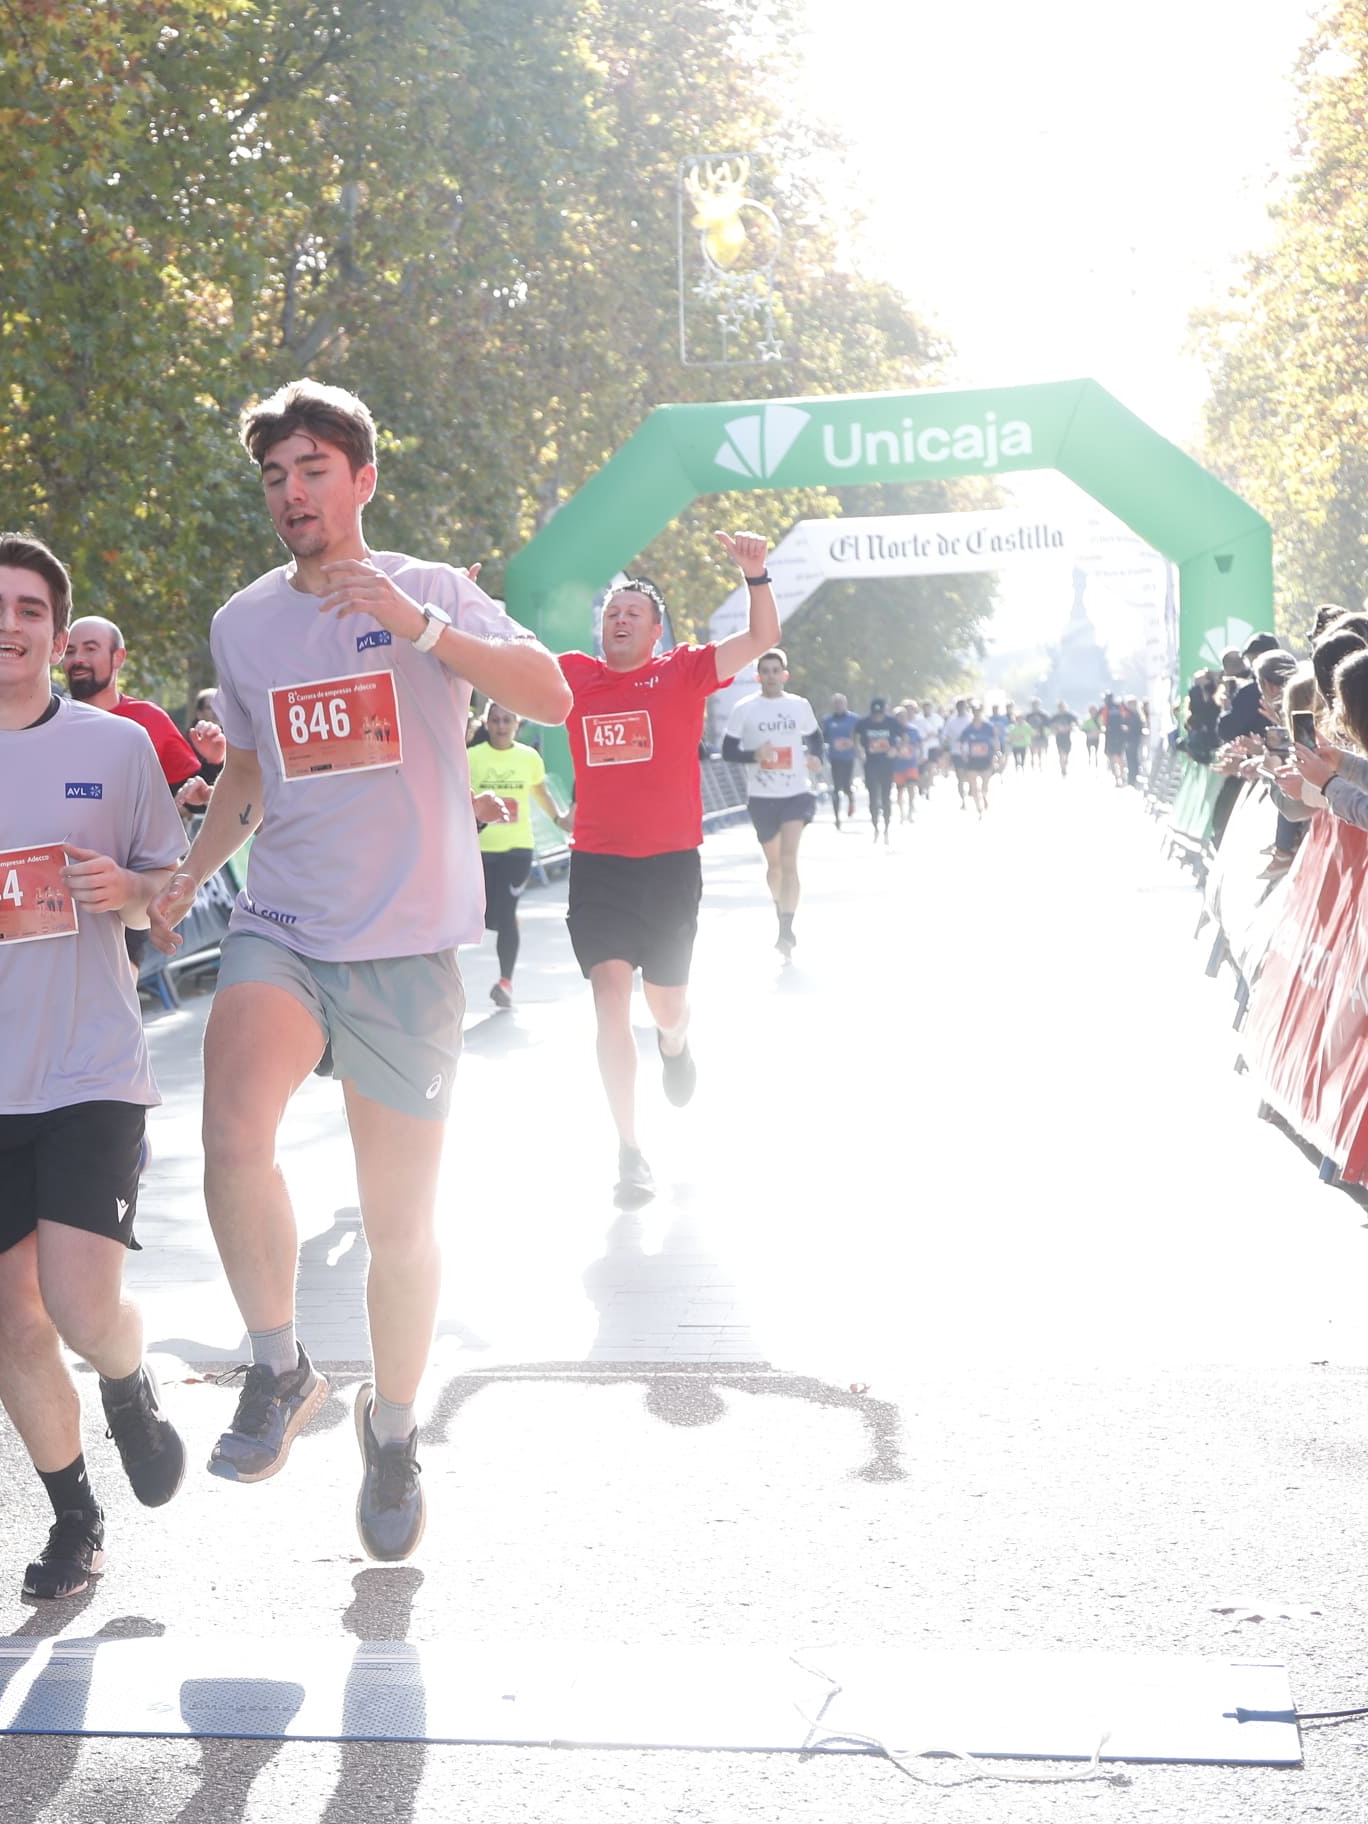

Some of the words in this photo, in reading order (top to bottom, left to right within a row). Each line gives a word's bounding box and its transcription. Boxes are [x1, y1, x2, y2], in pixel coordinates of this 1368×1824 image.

[822, 411, 1033, 468] Unicaja
[829, 534, 860, 562] El
[866, 533, 931, 561] Norte
[936, 532, 960, 556] de
[966, 524, 1065, 555] Castilla
[358, 635, 376, 649] AVL
[288, 698, 351, 744] 846
[758, 716, 796, 732] curia
[593, 723, 627, 747] 452
[67, 786, 87, 796] AVL
[27, 854, 50, 864] Adecco
